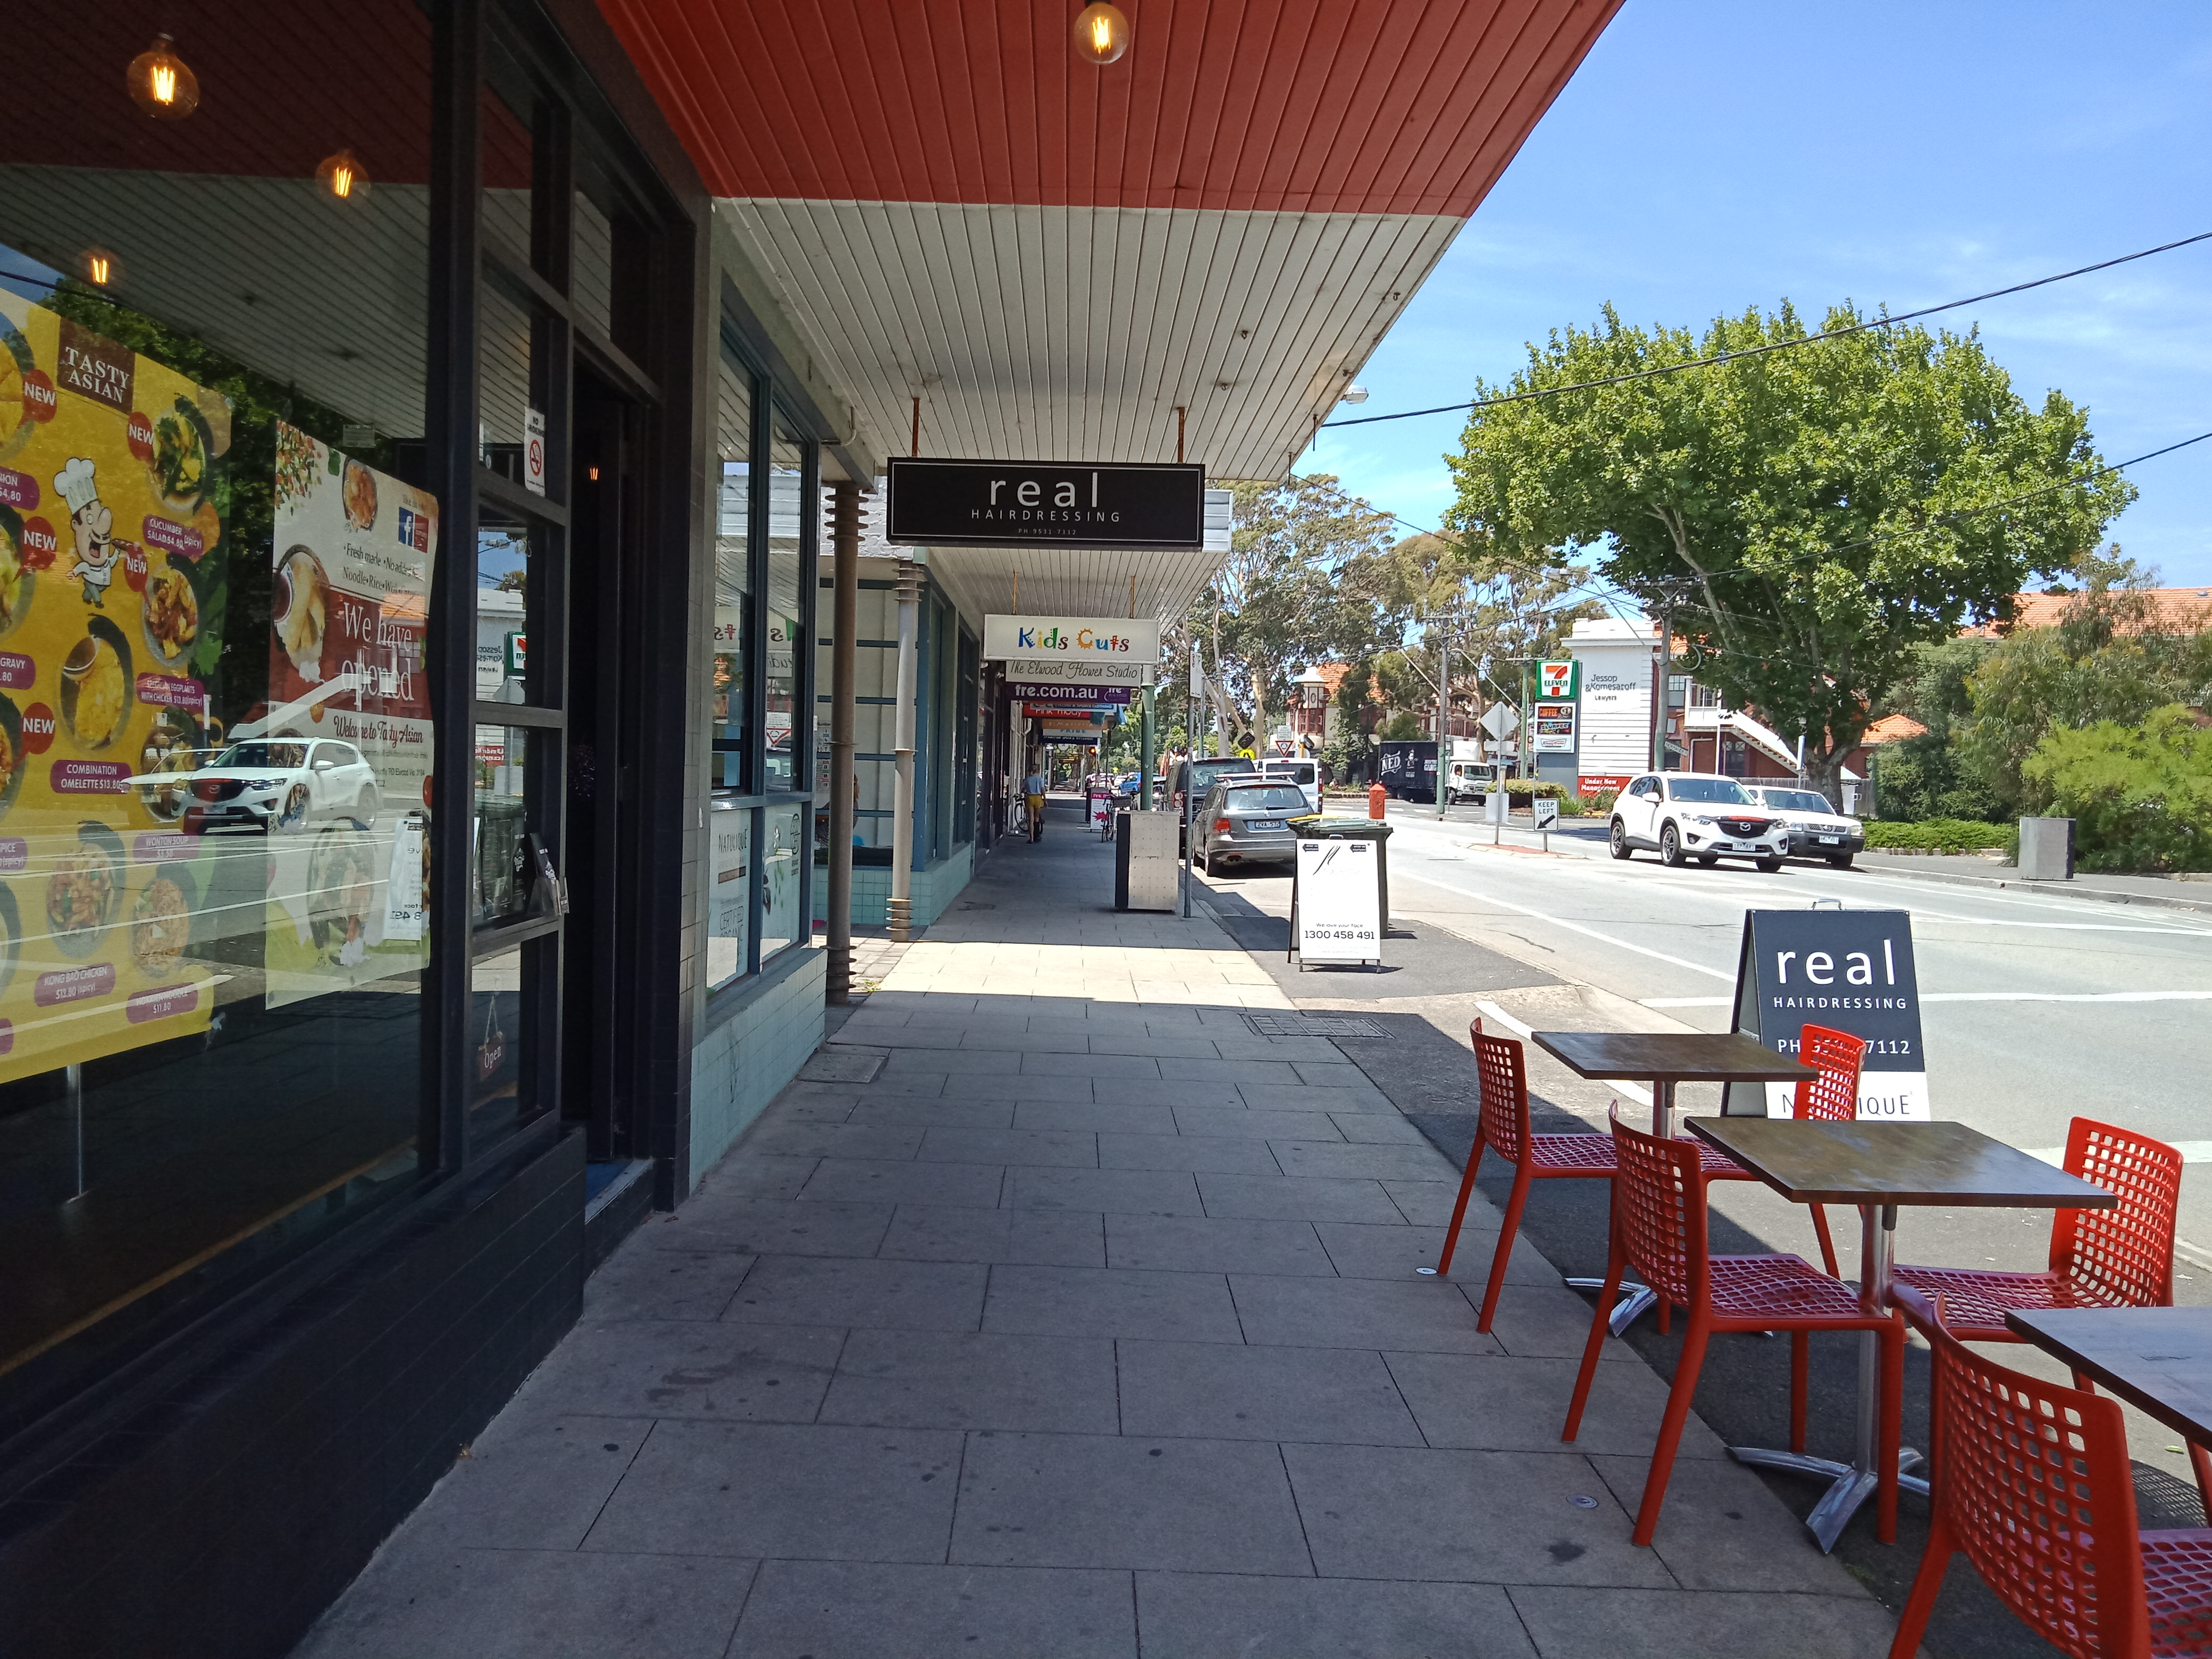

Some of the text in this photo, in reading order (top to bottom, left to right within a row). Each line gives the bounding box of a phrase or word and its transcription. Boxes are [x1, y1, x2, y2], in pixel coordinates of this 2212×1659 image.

[65, 346, 130, 389] TASTY
[24, 381, 56, 406] NEW
[68, 370, 123, 404] ASIAN
[129, 424, 154, 445] NEW
[990, 472, 1099, 507] real
[971, 509, 1120, 523] HAIRDRESSING
[149, 518, 182, 535] CUCUMBER
[24, 530, 56, 551] NEW
[184, 535, 202, 549] (spicy)
[127, 558, 147, 575] NEW
[365, 552, 381, 566] made
[386, 557, 395, 570] No
[343, 602, 412, 652] We have
[1018, 627, 1129, 652] Kids Cuts
[1, 657, 26, 669] GRAVY
[1027, 660, 1062, 675] Elwood
[1066, 660, 1102, 679] Flower
[1107, 665, 1138, 679] Studio
[341, 658, 415, 705] opened
[1591, 674, 1618, 683] Jessop
[171, 683, 195, 694] EGGPLANTS
[153, 693, 172, 703] CHICKEN
[1539, 708, 1558, 717] COFFEE
[23, 717, 55, 734] NEW
[399, 724, 424, 743] Asian
[66, 764, 117, 775] COMBINATION
[1382, 756, 1401, 772] NED
[61, 778, 98, 789] OMELETTE
[146, 837, 171, 846] WONTON
[718, 829, 747, 853] NATULIQUE
[1777, 939, 1895, 985] real
[45, 966, 107, 986] KONG BAO CHICKEN
[153, 1002, 171, 1013] $11.80
[1774, 997, 1907, 1009] HAIRDRESSING
[484, 1046, 501, 1069] Open
